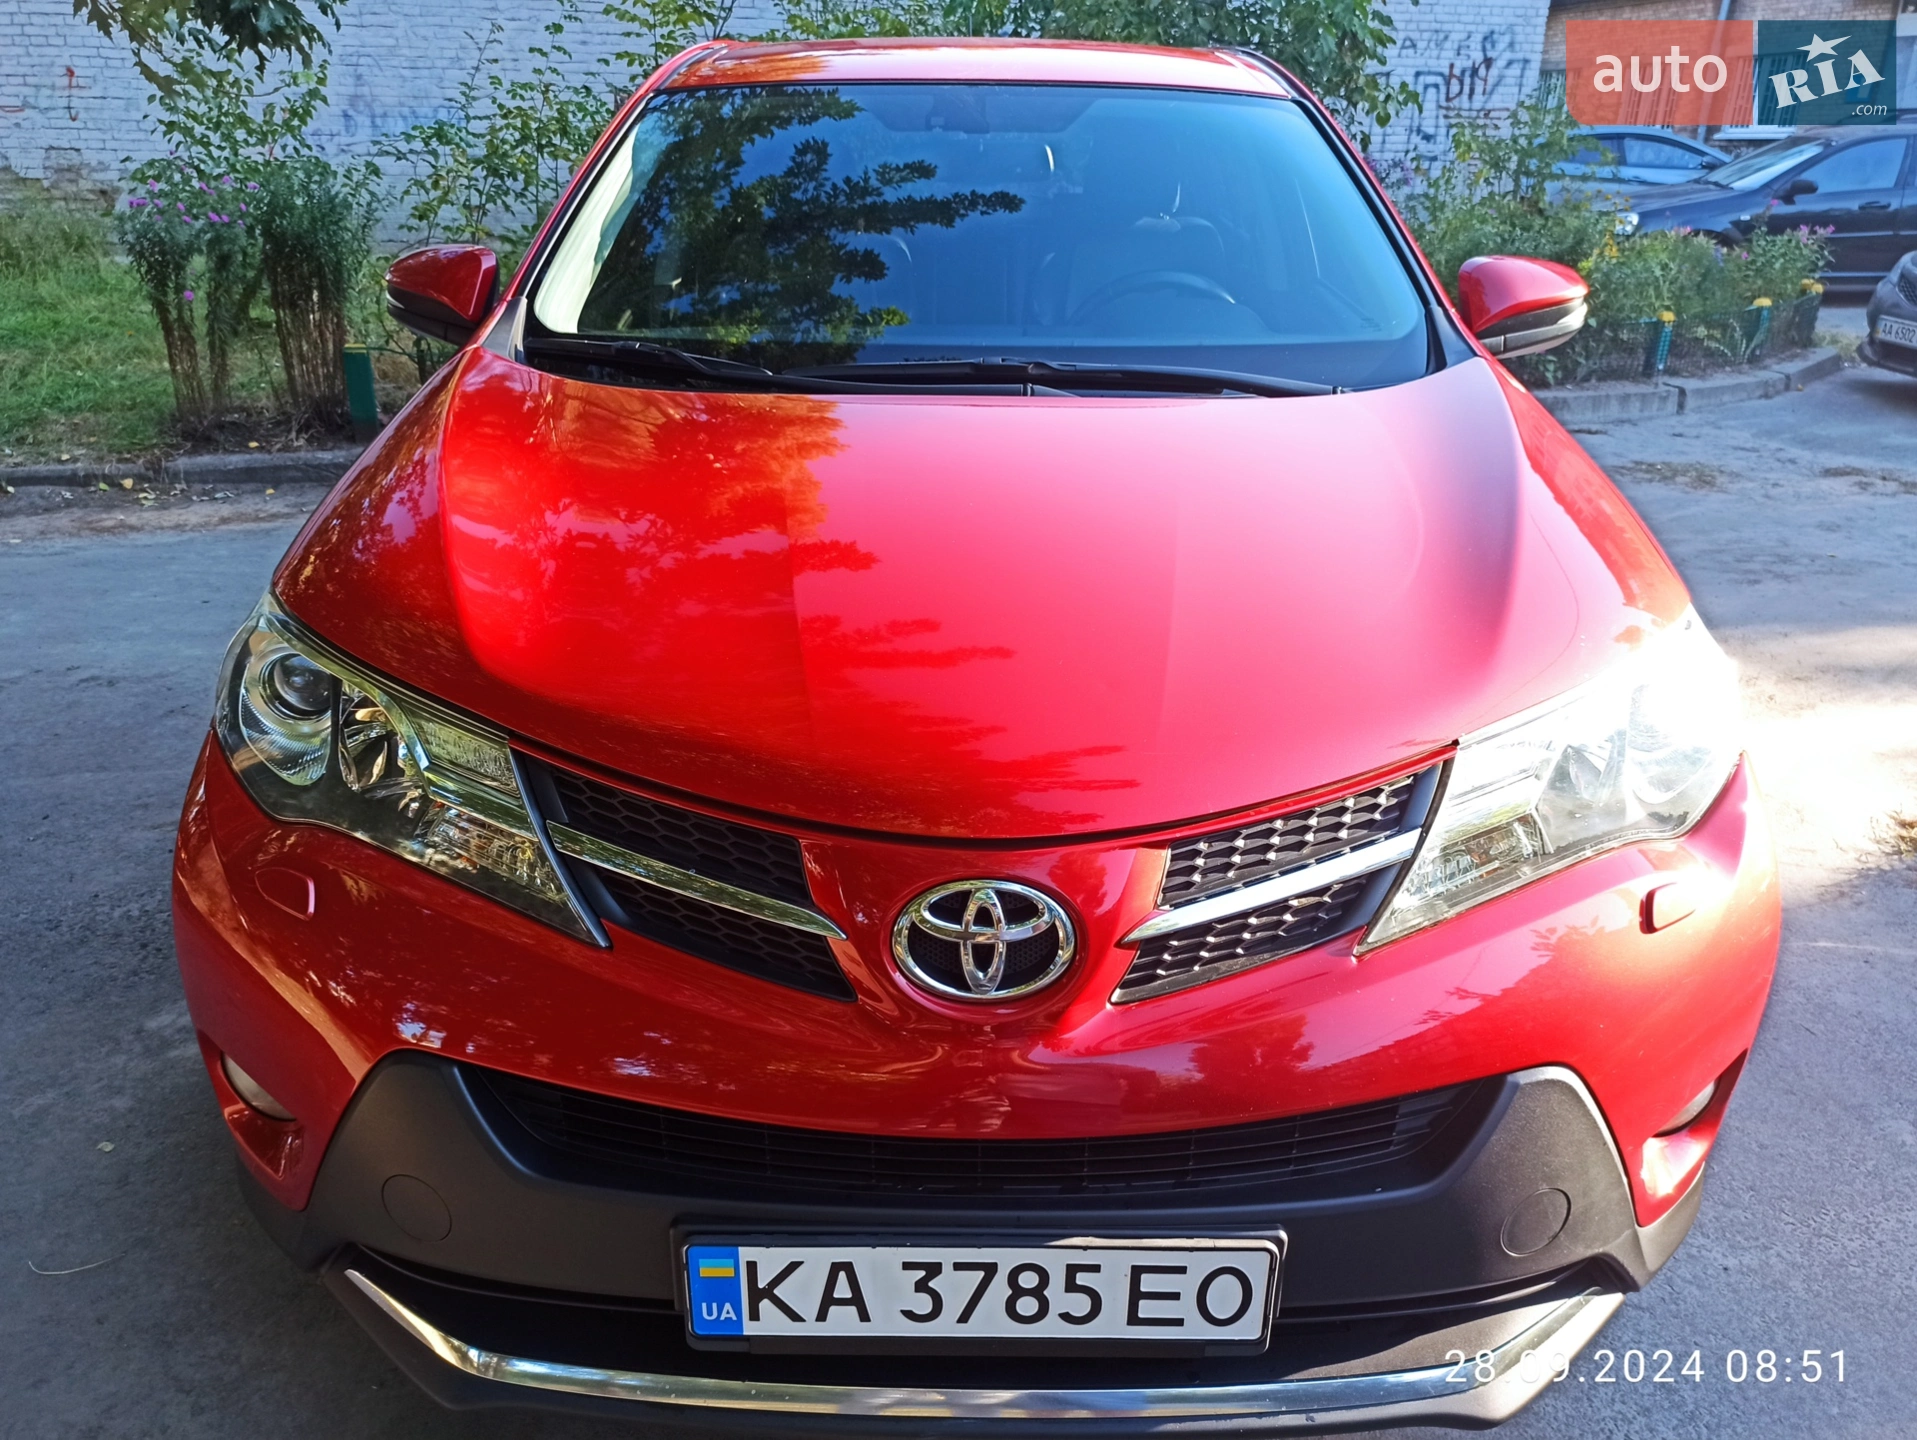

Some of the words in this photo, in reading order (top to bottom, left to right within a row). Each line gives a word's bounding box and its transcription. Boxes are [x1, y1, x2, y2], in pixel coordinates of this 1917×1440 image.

[702, 1302, 737, 1321] UA
[746, 1260, 871, 1323] KA
[900, 1261, 1103, 1325] 3785
[1126, 1264, 1253, 1327] EO
